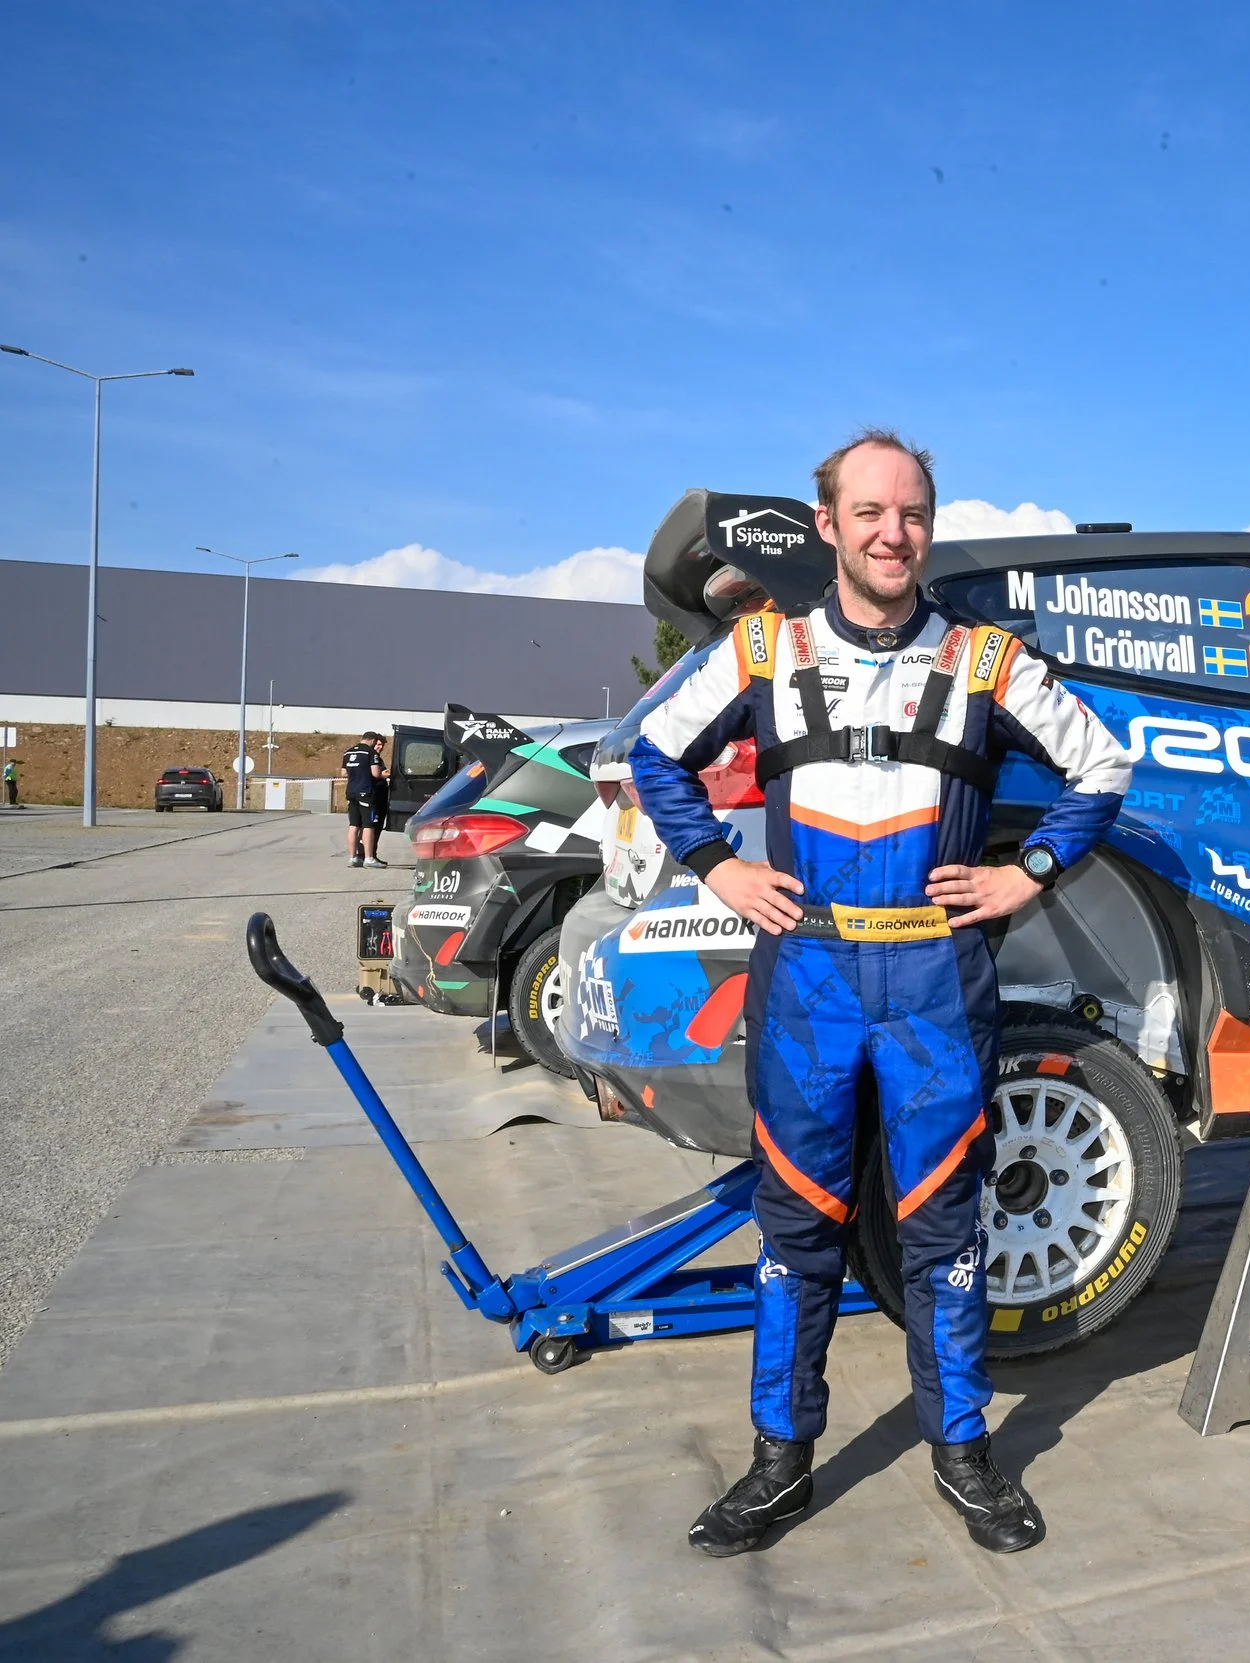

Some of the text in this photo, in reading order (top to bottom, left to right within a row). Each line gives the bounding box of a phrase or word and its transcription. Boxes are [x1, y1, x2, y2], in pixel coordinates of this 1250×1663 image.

[736, 527, 805, 548] Sjötorps
[761, 545, 782, 555] Hus
[1007, 570, 1192, 625] M Johansson
[748, 617, 767, 663] sparco
[791, 622, 811, 664] SIMPSON
[940, 629, 963, 670] SIMPSON
[1056, 625, 1197, 674] J Grönvall
[901, 654, 934, 665] WR
[975, 633, 1003, 680] sparco
[821, 678, 847, 686] KOOK
[433, 870, 460, 893] Leil
[867, 918, 937, 930] J.GRÖNVALL
